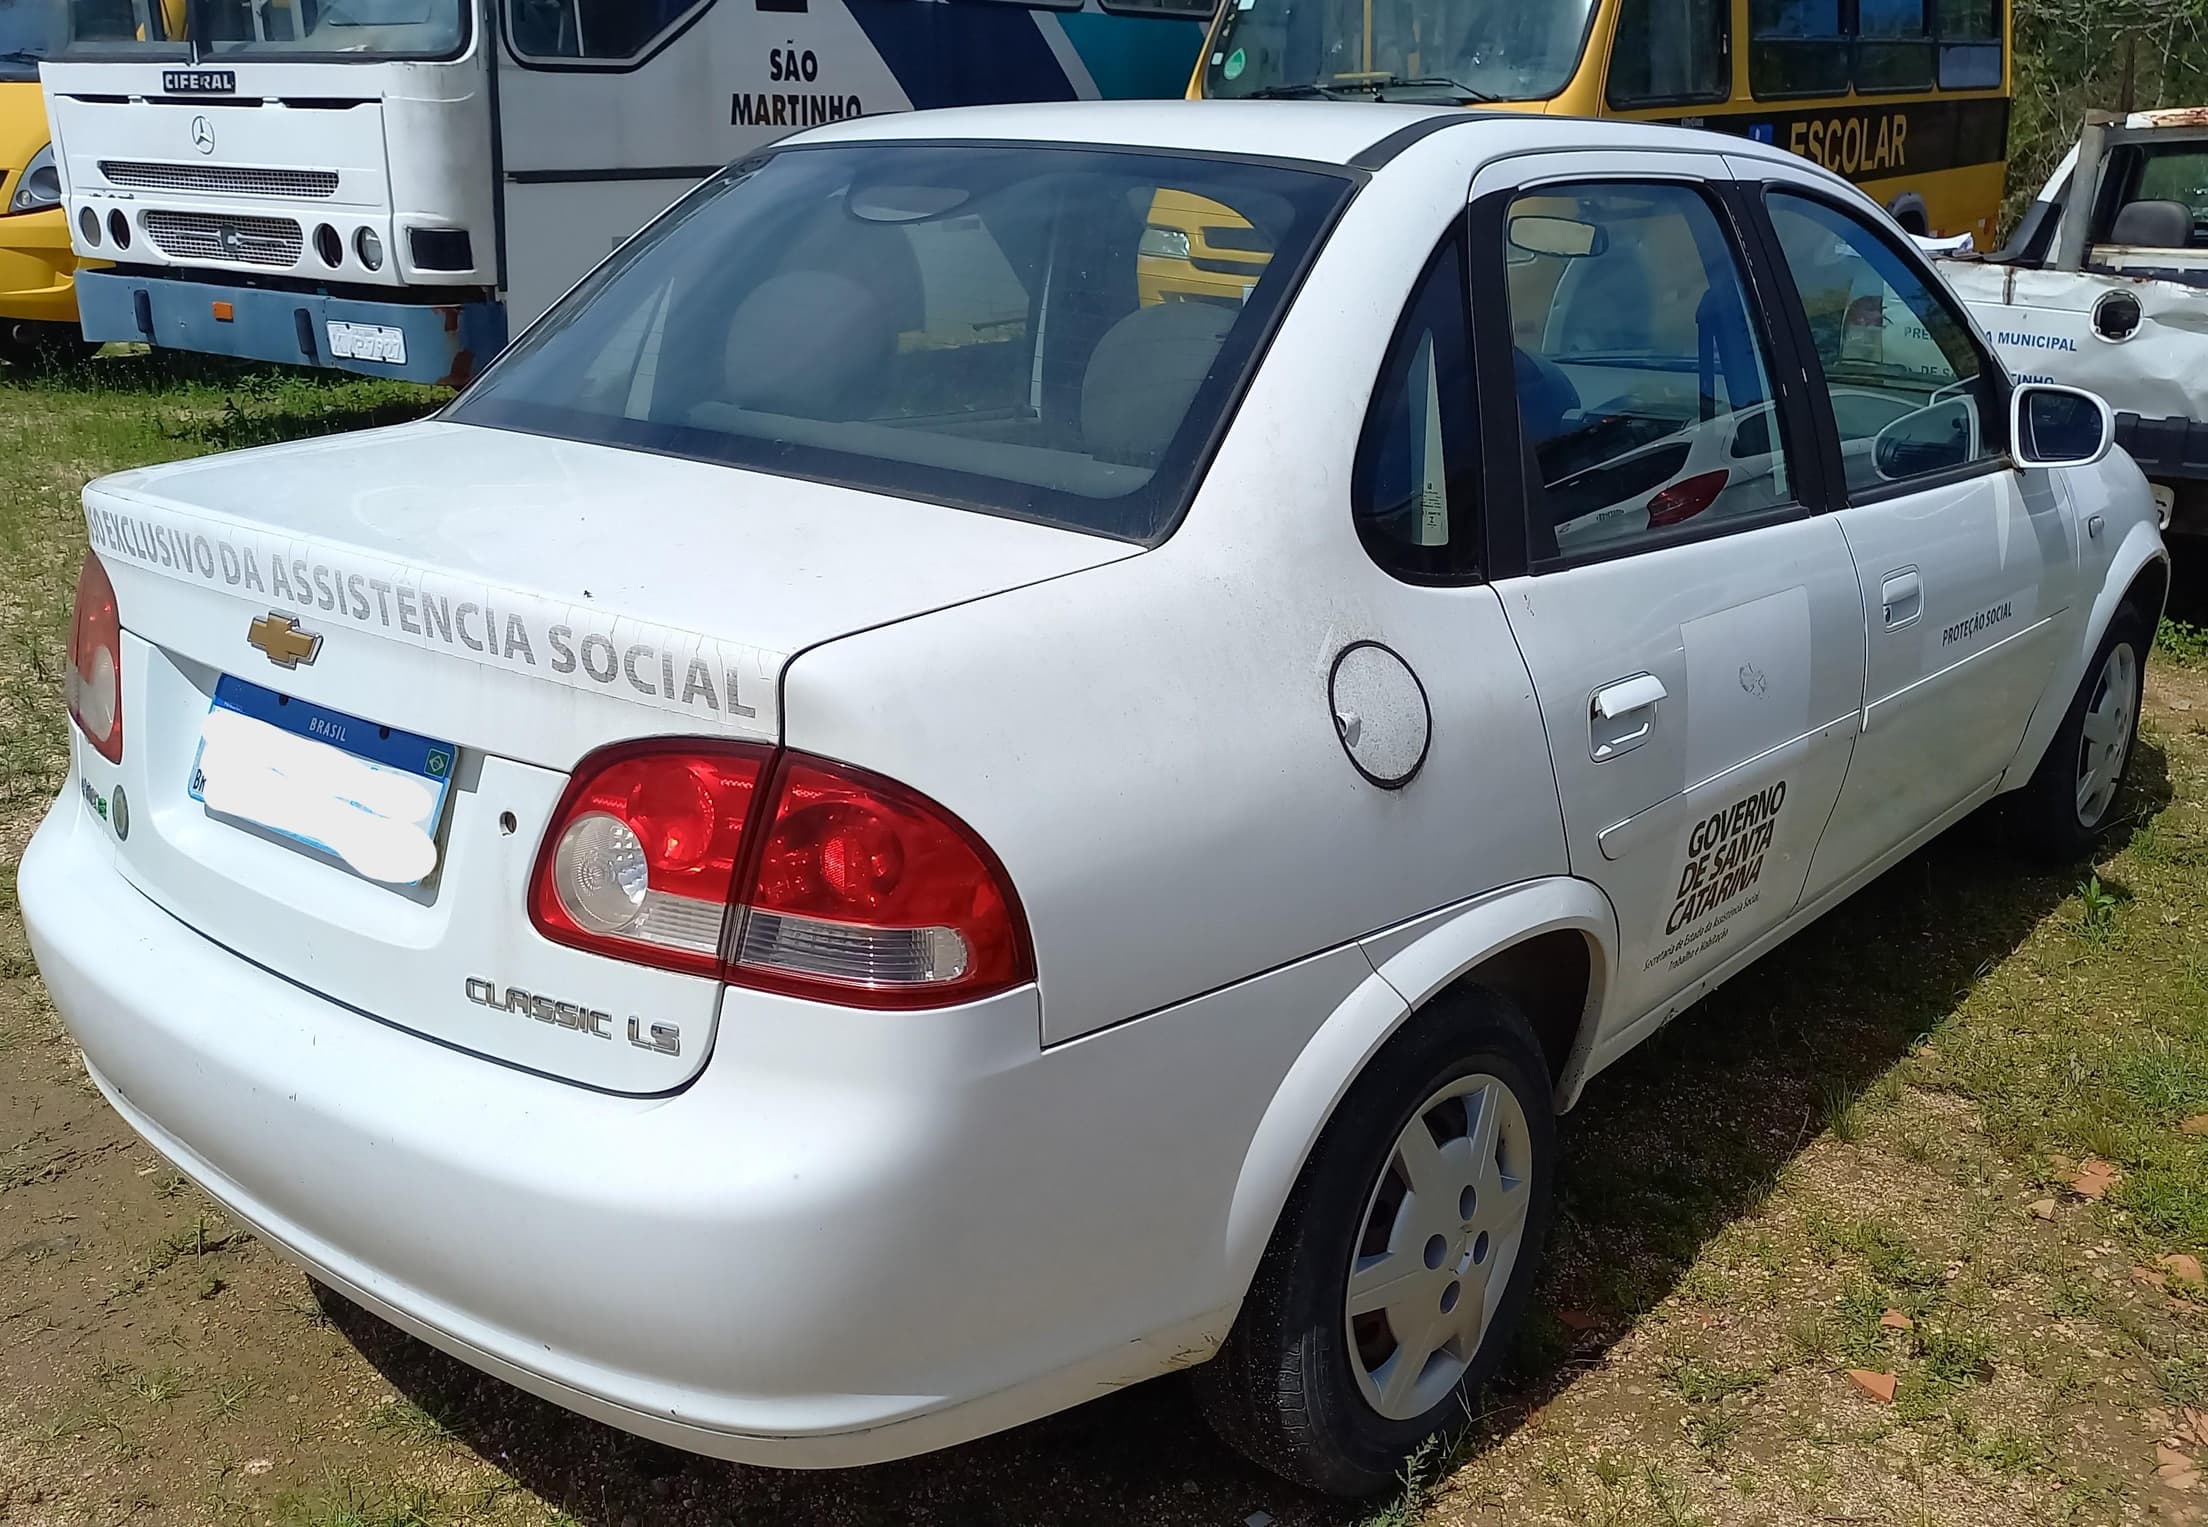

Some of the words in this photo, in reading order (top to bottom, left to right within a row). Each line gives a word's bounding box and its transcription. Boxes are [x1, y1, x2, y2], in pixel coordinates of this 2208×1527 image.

[165, 73, 232, 90] CIFERAL
[769, 40, 818, 82] SÃO
[730, 93, 863, 126] MARTINHO
[1790, 114, 1907, 175] ESCOLAR
[1998, 332, 2078, 352] MUNICIPAL
[102, 510, 215, 580] EXCLUSIVO
[216, 540, 265, 593] DA
[271, 552, 537, 665] ASSISTÊNCIA
[547, 622, 757, 719] SOCIAL
[1942, 612, 1985, 648] PROTEÇÃO
[1985, 601, 2012, 628] SOCIAL
[309, 717, 346, 742] BRASIL
[1688, 780, 1787, 859] GOVERNO
[1676, 853, 1710, 900] DE
[1708, 818, 1775, 882] SANTA
[1665, 854, 1764, 936] CATARINA
[465, 977, 612, 1040] CLASSIC
[627, 1015, 681, 1057] LS
